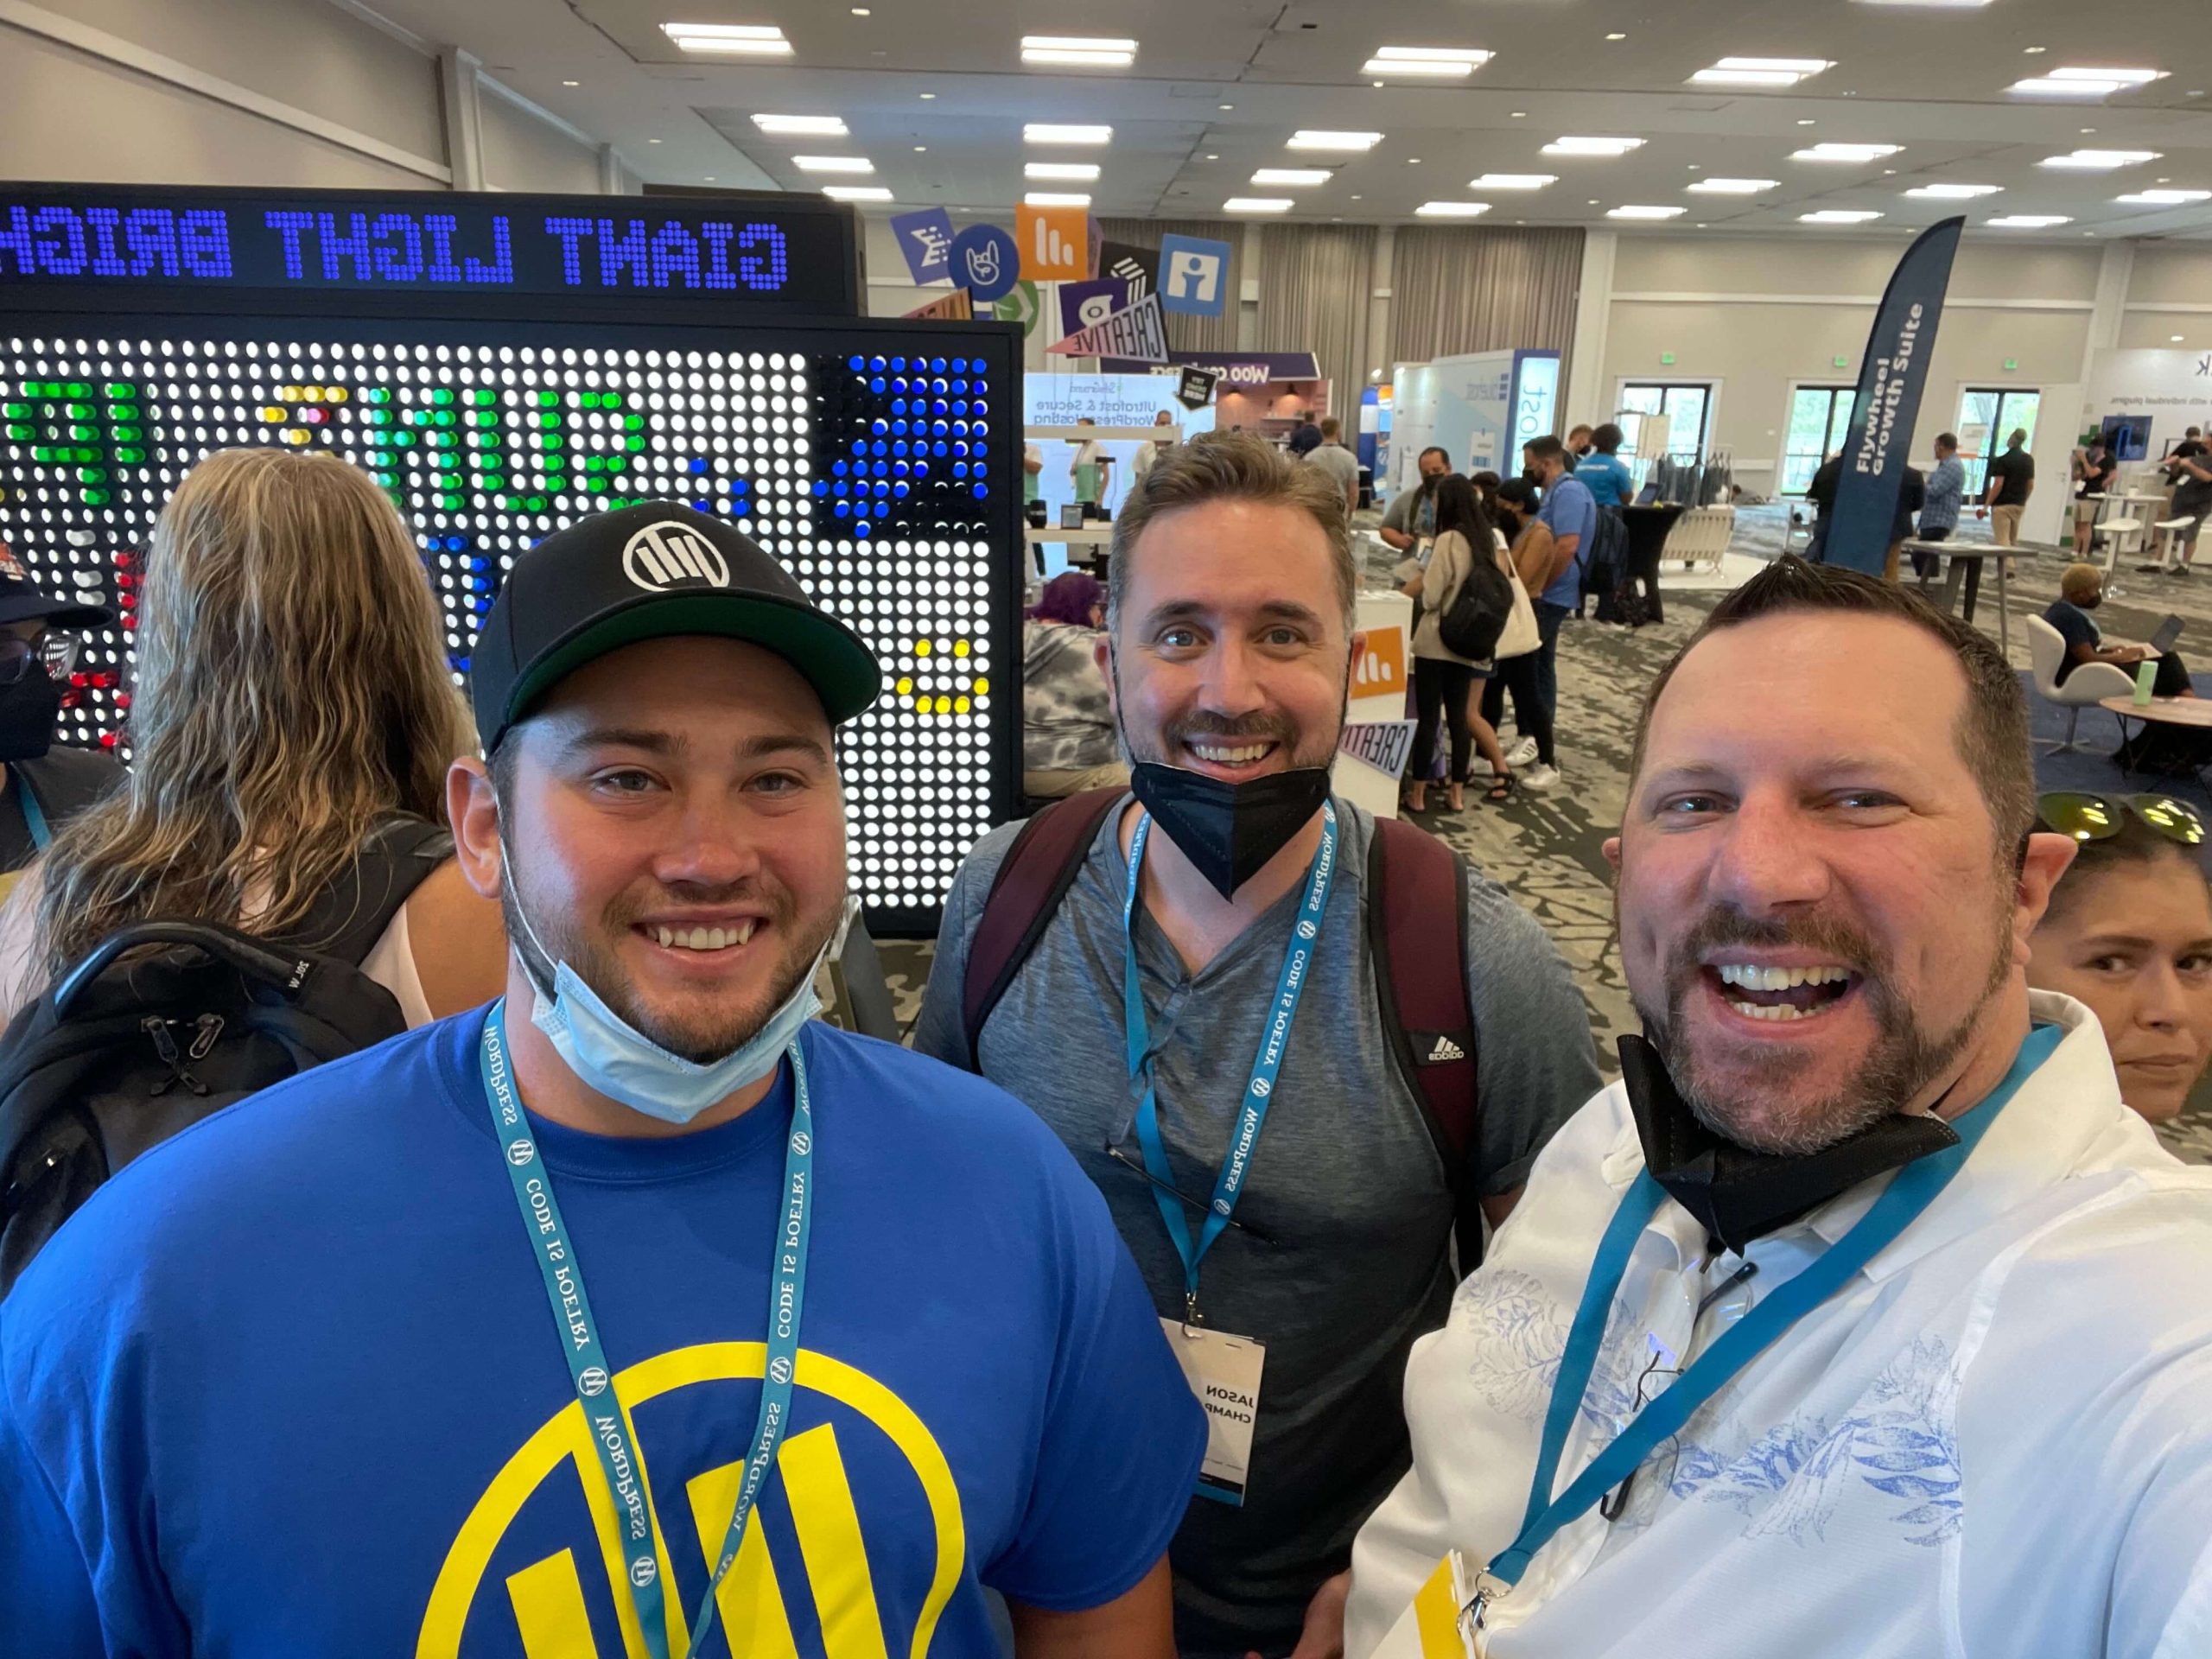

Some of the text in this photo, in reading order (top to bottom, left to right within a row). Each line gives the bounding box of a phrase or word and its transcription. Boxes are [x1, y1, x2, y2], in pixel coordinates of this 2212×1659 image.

[1855, 357, 1891, 474] Flywheel
[1872, 302, 1923, 477] Growth Suite
